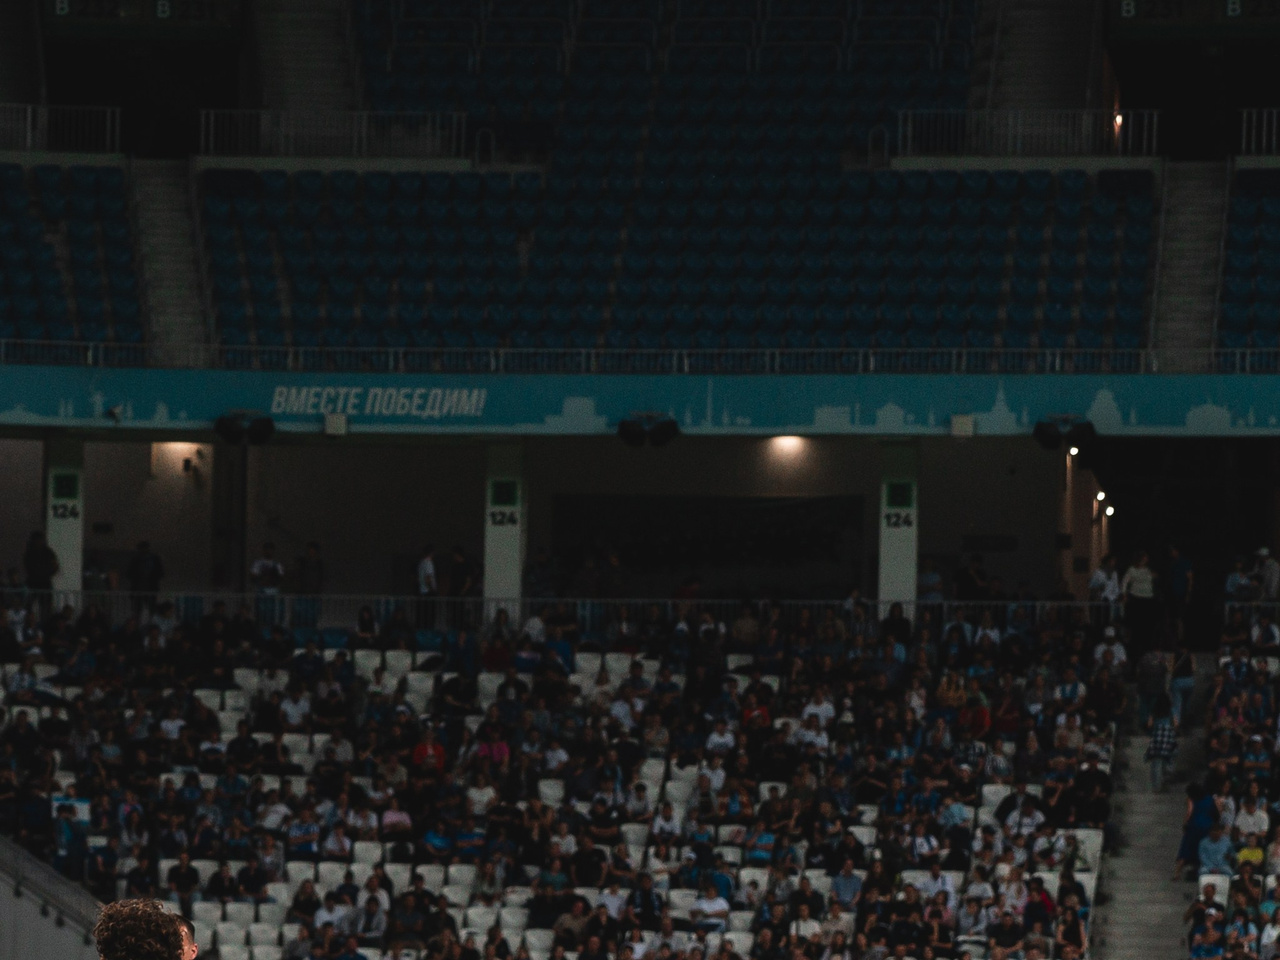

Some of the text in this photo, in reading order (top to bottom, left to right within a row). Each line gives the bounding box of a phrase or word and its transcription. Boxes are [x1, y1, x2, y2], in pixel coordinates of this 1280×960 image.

[271, 385, 489, 419] ВМЕСТЕ ПОБЕДИМ!
[52, 503, 79, 519] 124
[490, 511, 517, 526] 124
[885, 513, 913, 528] 124
